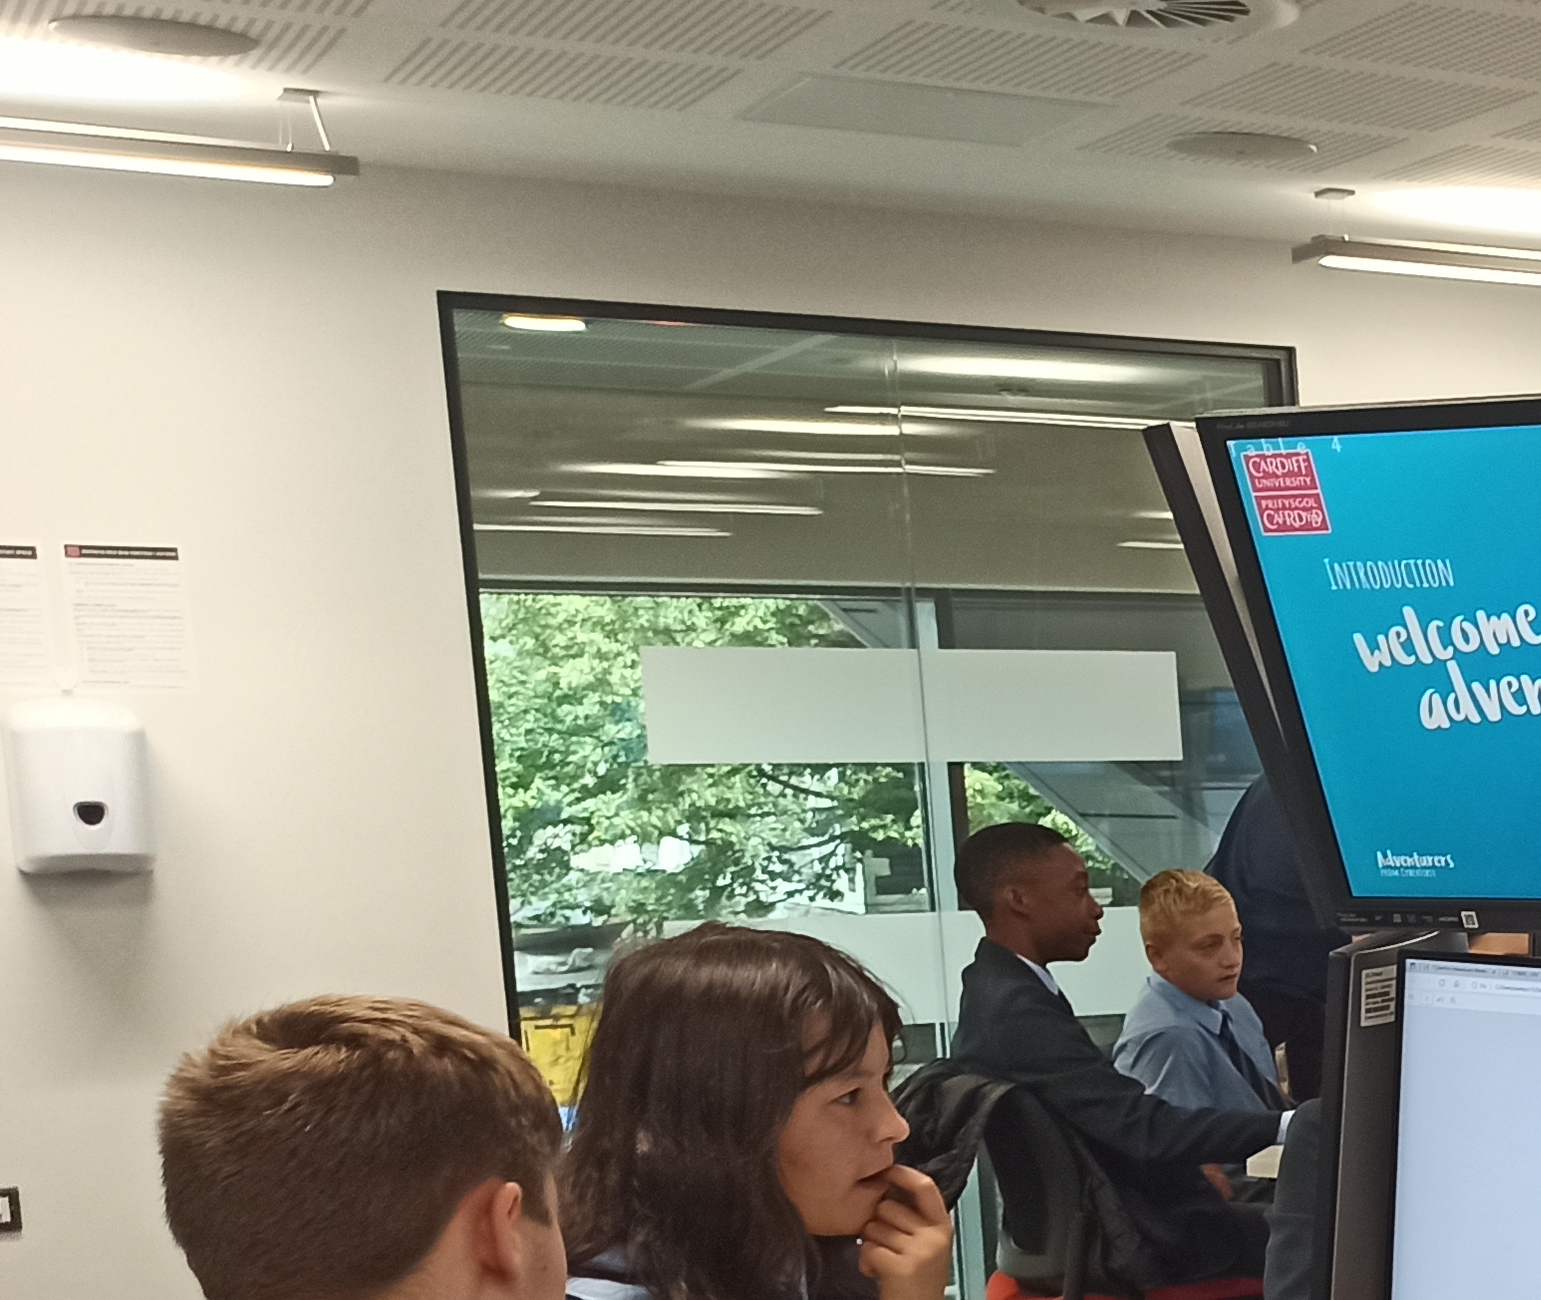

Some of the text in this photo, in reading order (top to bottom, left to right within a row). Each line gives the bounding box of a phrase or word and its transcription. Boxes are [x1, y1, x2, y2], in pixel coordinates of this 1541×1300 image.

[1331, 437, 1342, 453] 4
[1249, 455, 1309, 477] CARDIFF
[1255, 475, 1312, 488] UNIVERSITY
[1261, 498, 1318, 510] PRIFYSGOL
[1377, 849, 1455, 869] Adventurers
